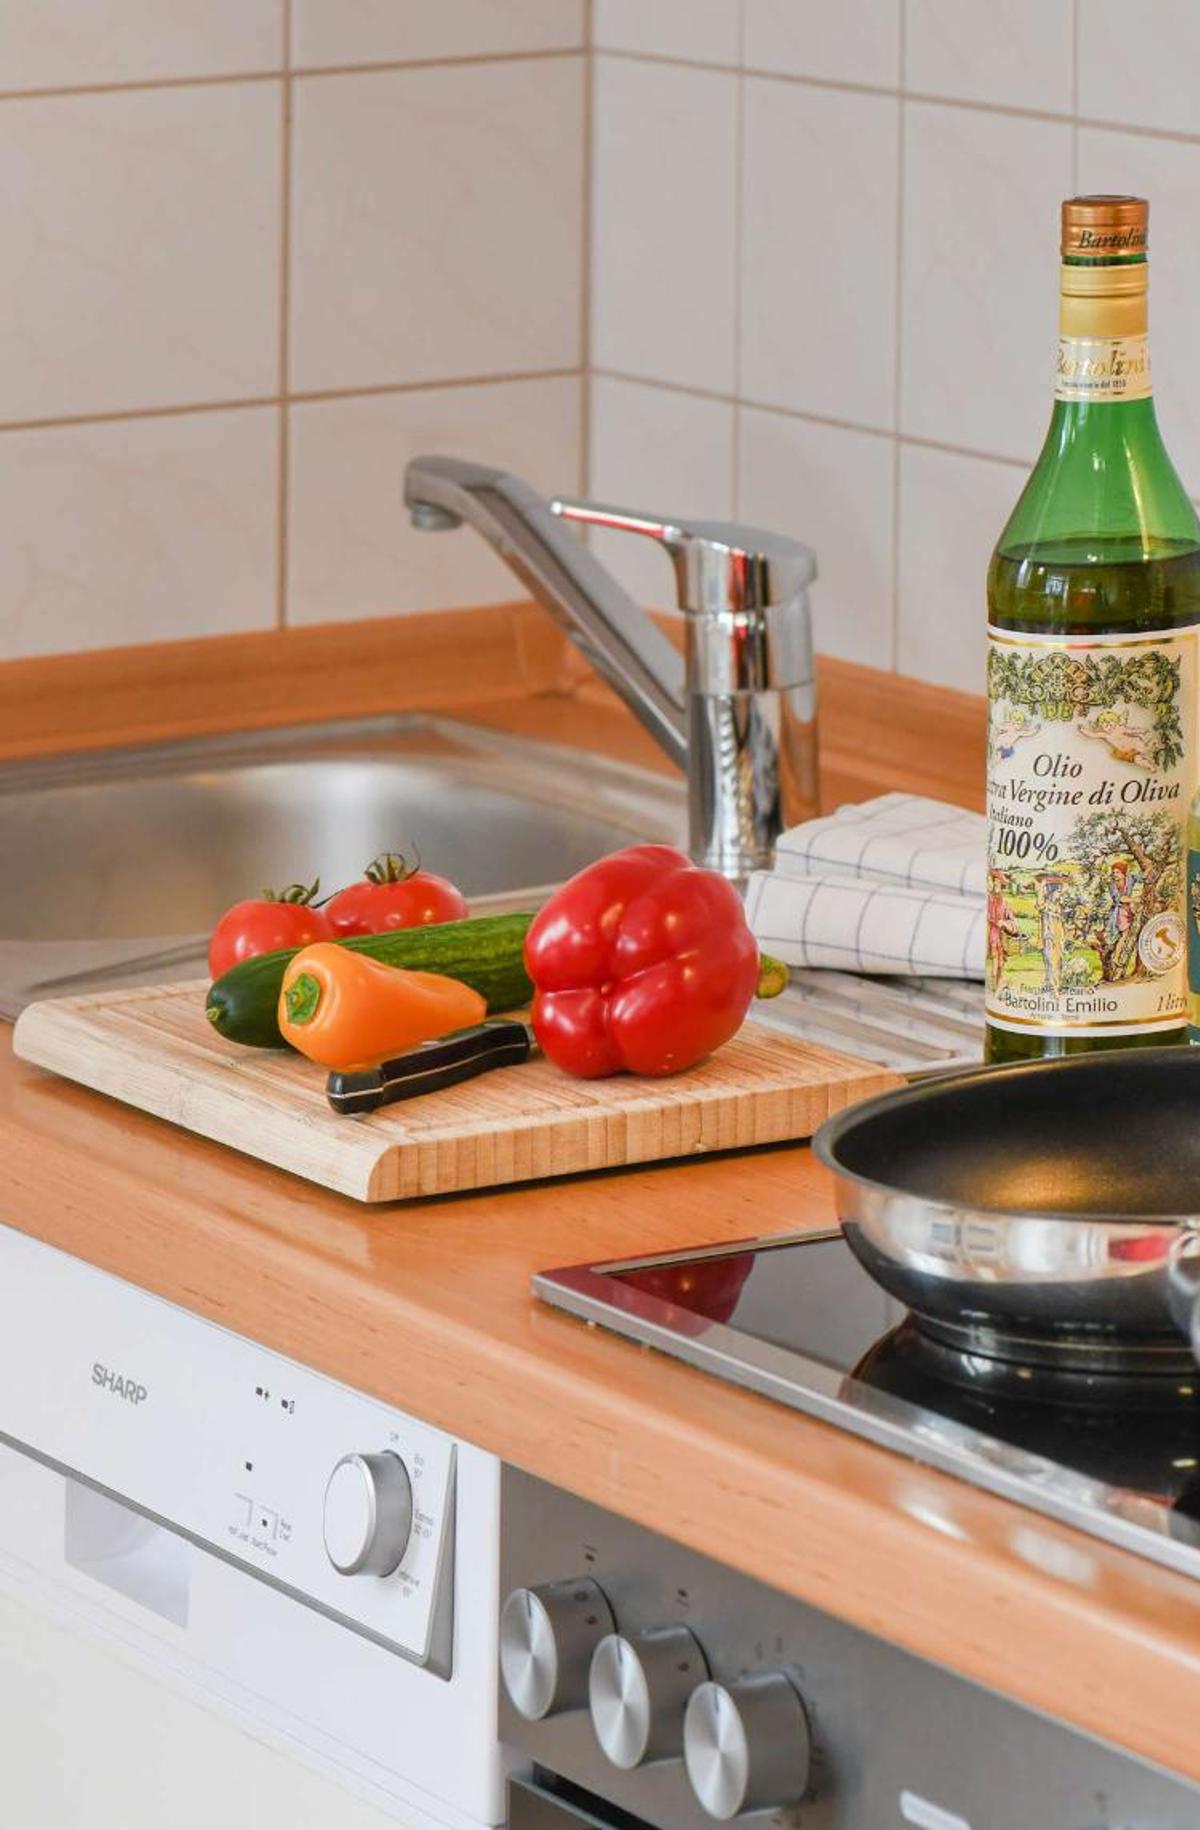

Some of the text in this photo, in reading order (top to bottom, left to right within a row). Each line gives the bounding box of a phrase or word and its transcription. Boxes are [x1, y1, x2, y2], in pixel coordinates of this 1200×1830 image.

[1032, 752, 1084, 778] Olio
[1010, 778, 1084, 813] Vergine
[1088, 780, 1115, 806] di
[1120, 777, 1181, 804] Oliva
[997, 827, 1059, 861] 100%
[1004, 993, 1119, 1013] Bartolini Emilio
[91, 1363, 148, 1406] SHARP
